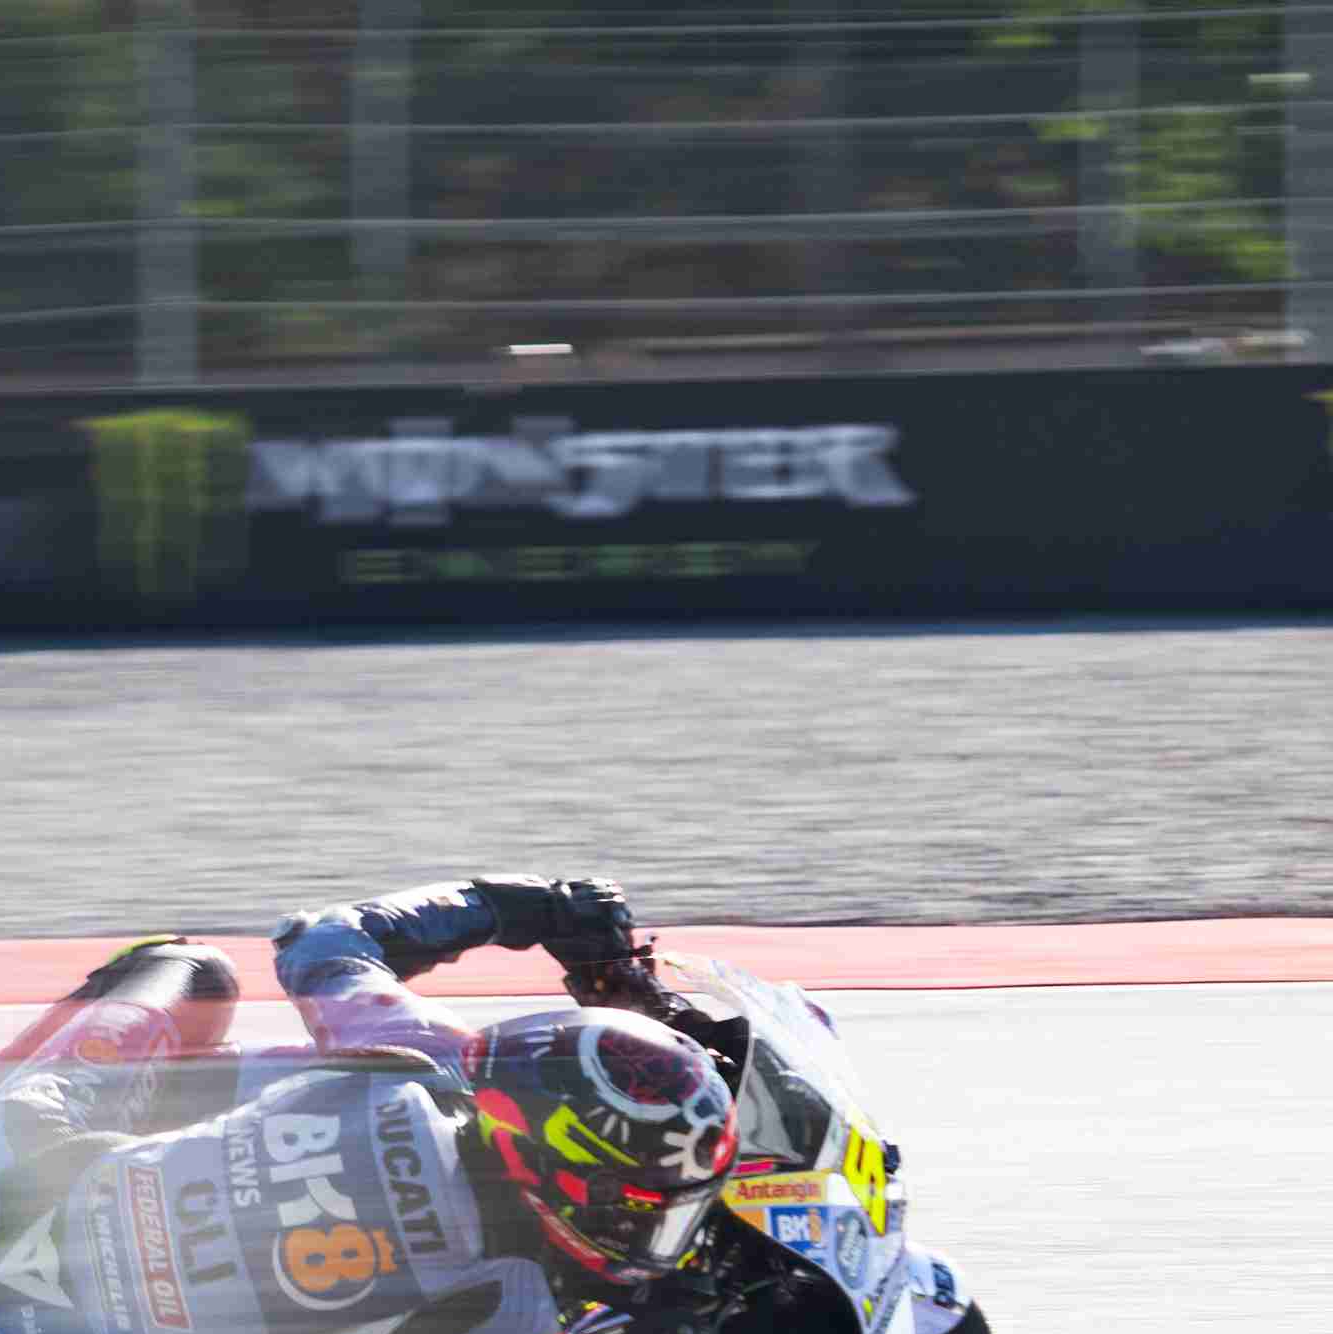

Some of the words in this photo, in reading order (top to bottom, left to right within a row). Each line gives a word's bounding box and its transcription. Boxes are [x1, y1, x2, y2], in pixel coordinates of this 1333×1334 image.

[250, 417, 914, 523] MONSTER
[226, 1112, 261, 1208] NEWS
[263, 1113, 379, 1293] BK8
[133, 1170, 174, 1273] FEDERAL
[149, 1280, 183, 1318] OIL
